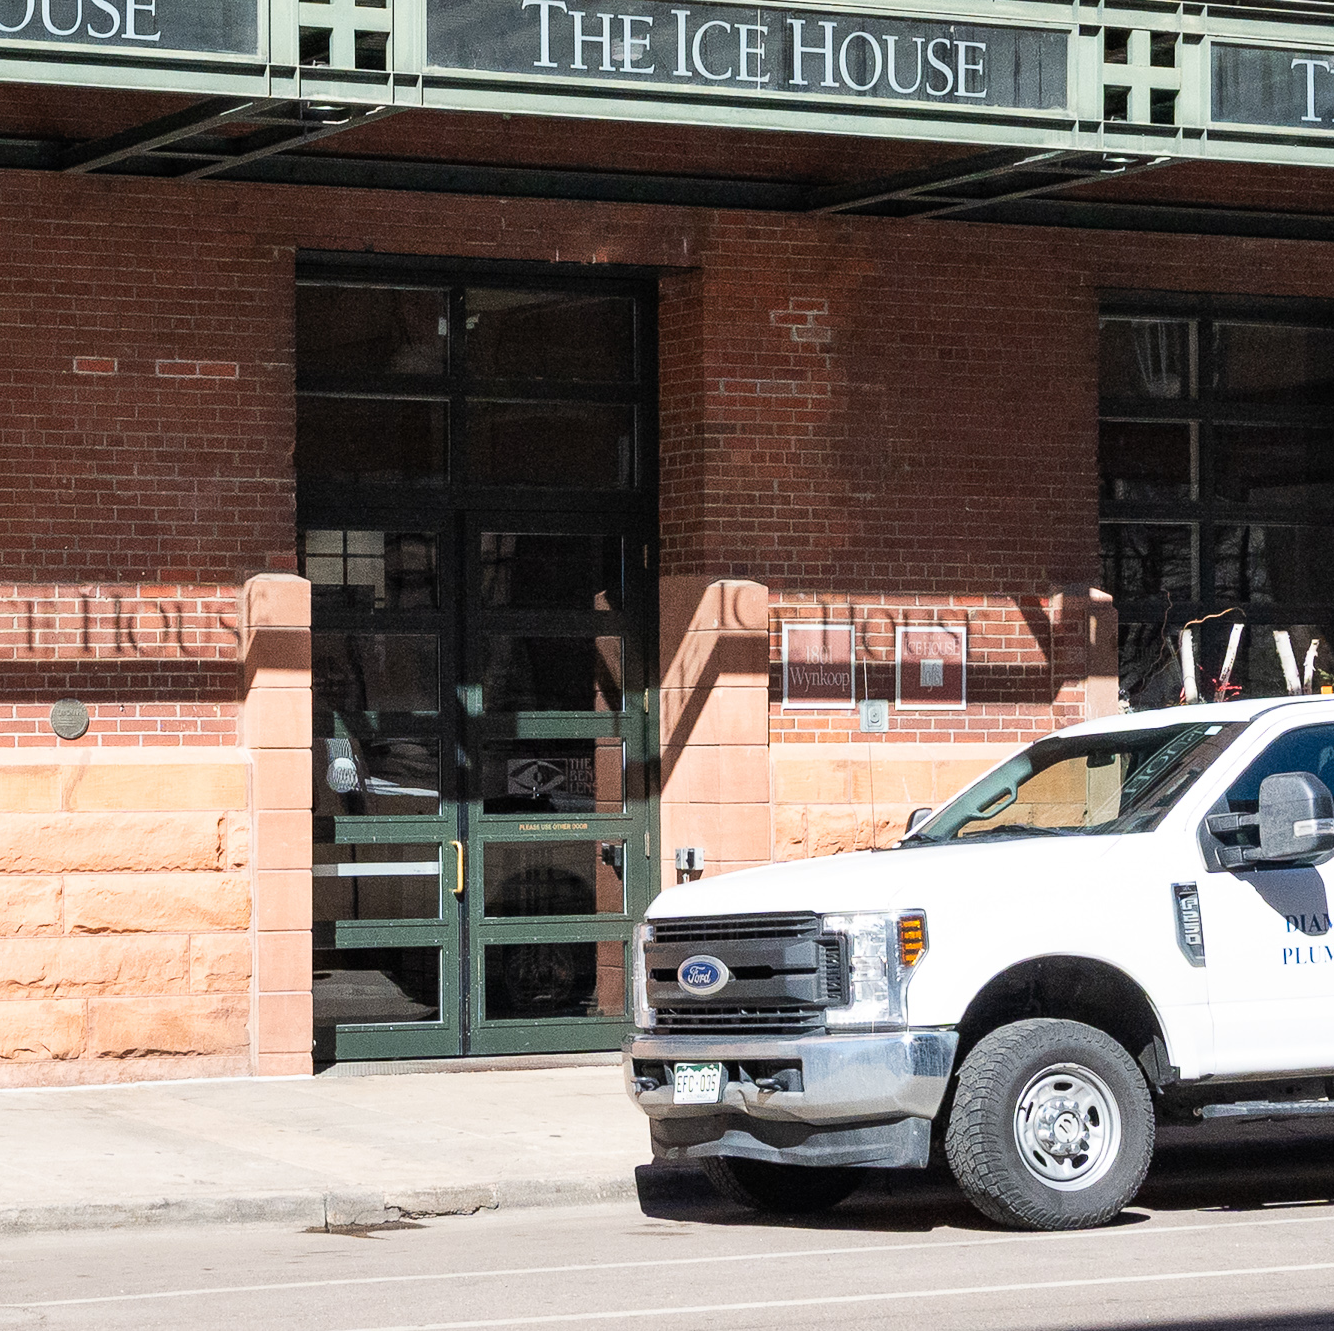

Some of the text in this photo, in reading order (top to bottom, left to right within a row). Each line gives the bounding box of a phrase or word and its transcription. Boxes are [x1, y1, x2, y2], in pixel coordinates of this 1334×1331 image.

[671, 9, 769, 83] ICE
[787, 18, 988, 99] HOUSE
[805, 645, 833, 664] 1801
[789, 666, 851, 692] Wynkoop
[569, 758, 592, 770] THE
[687, 965, 712, 984] Ford
